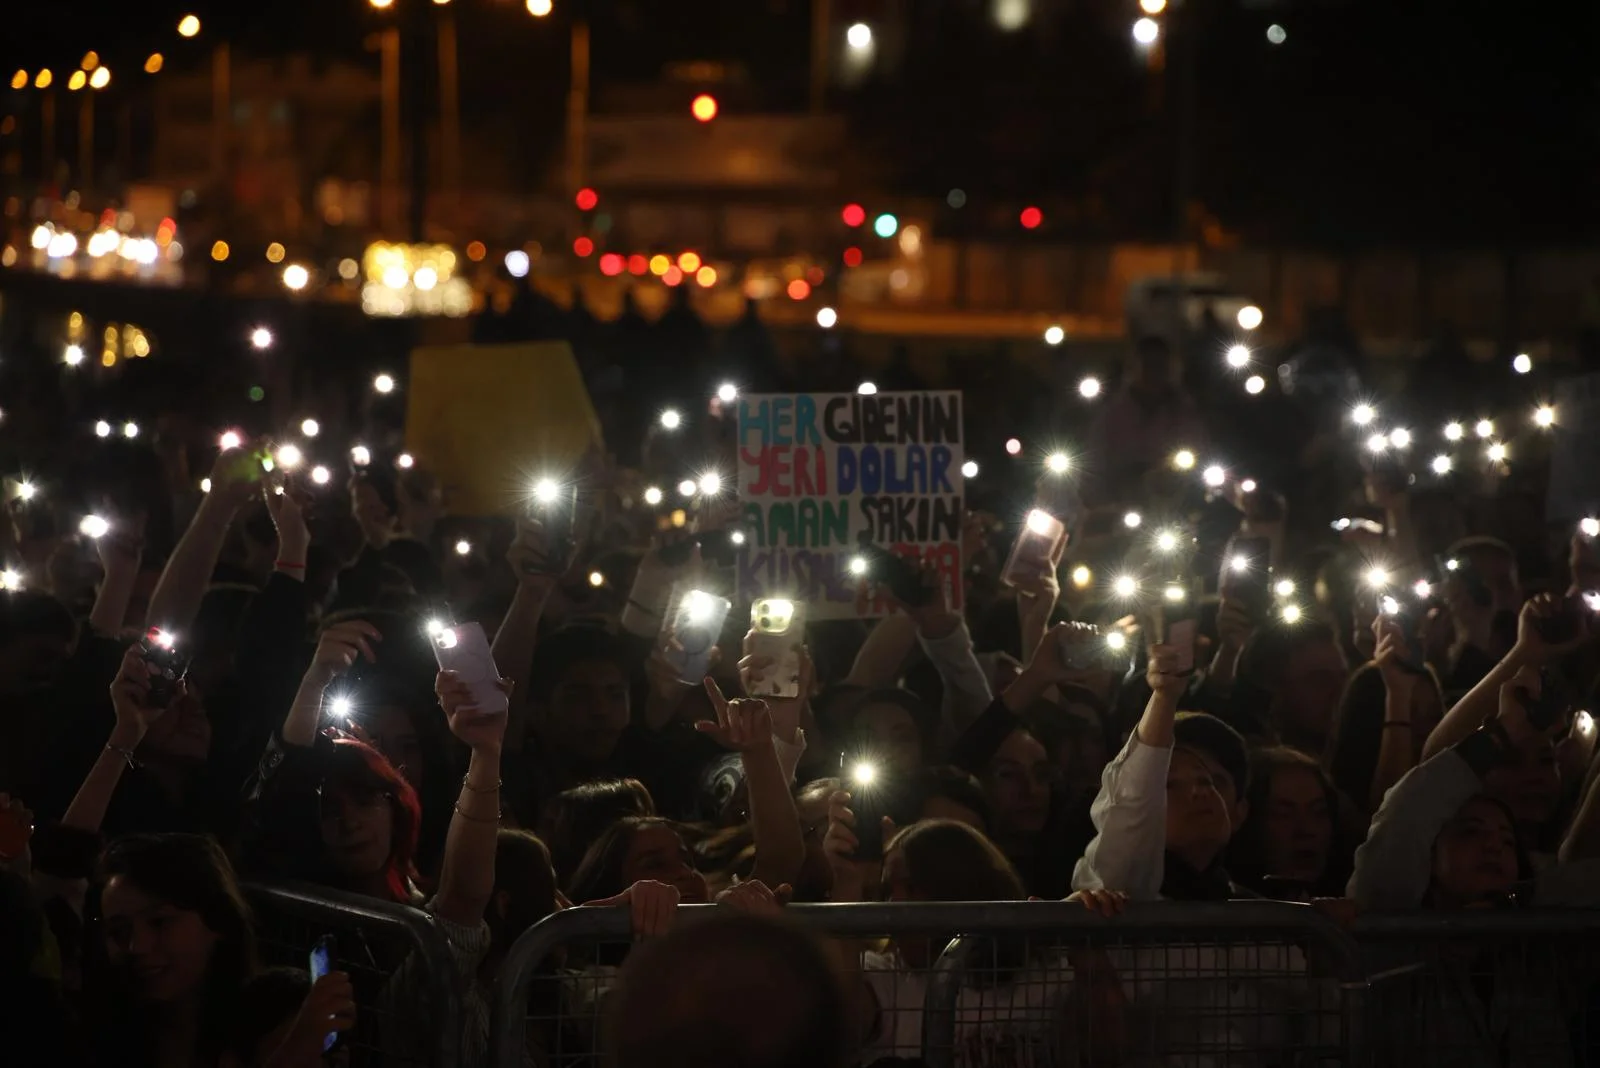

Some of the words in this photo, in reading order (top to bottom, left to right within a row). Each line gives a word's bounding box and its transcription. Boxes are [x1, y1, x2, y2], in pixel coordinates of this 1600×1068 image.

[739, 395, 822, 445] HER
[838, 442, 955, 496] DOLAR
[743, 498, 849, 548] AMAN
[857, 496, 961, 543] SAKIN
